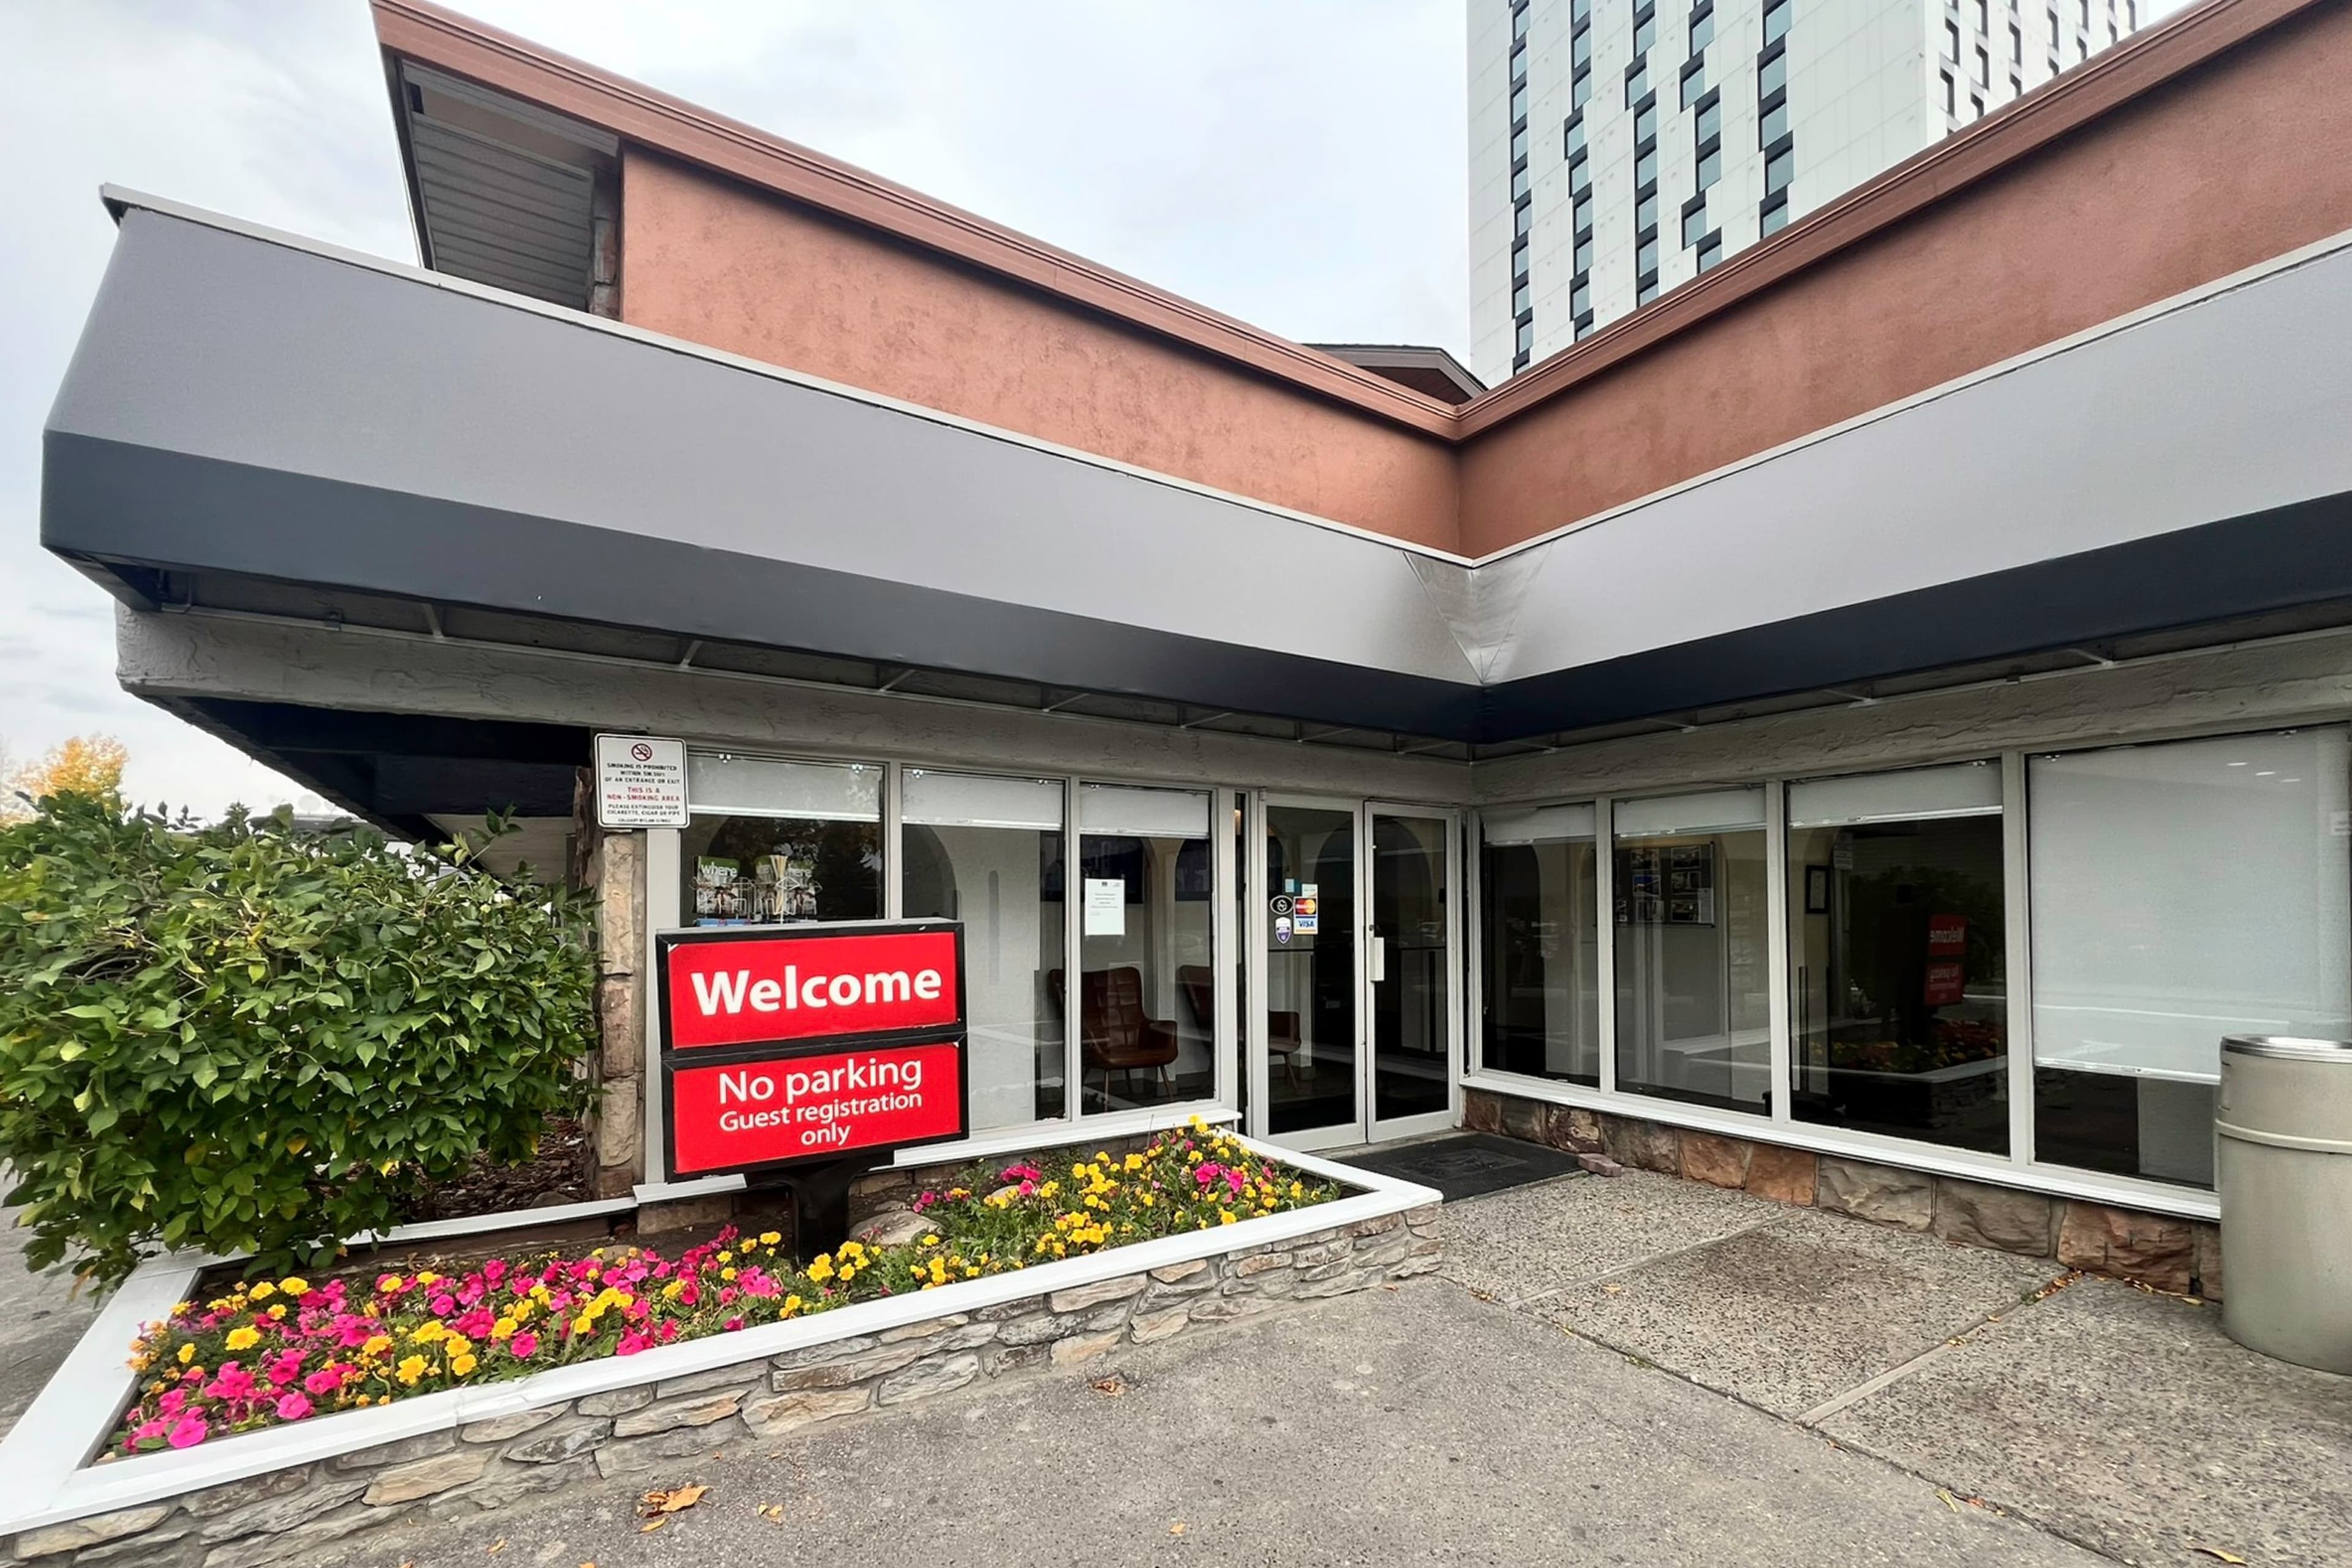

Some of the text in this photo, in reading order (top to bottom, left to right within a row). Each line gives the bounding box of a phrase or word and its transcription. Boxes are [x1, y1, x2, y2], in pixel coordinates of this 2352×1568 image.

[701, 861, 738, 876] where
[691, 965, 941, 1016] Welcome
[719, 1058, 922, 1104] No parking
[719, 1092, 922, 1132] Guest registration
[801, 1121, 851, 1147] only
